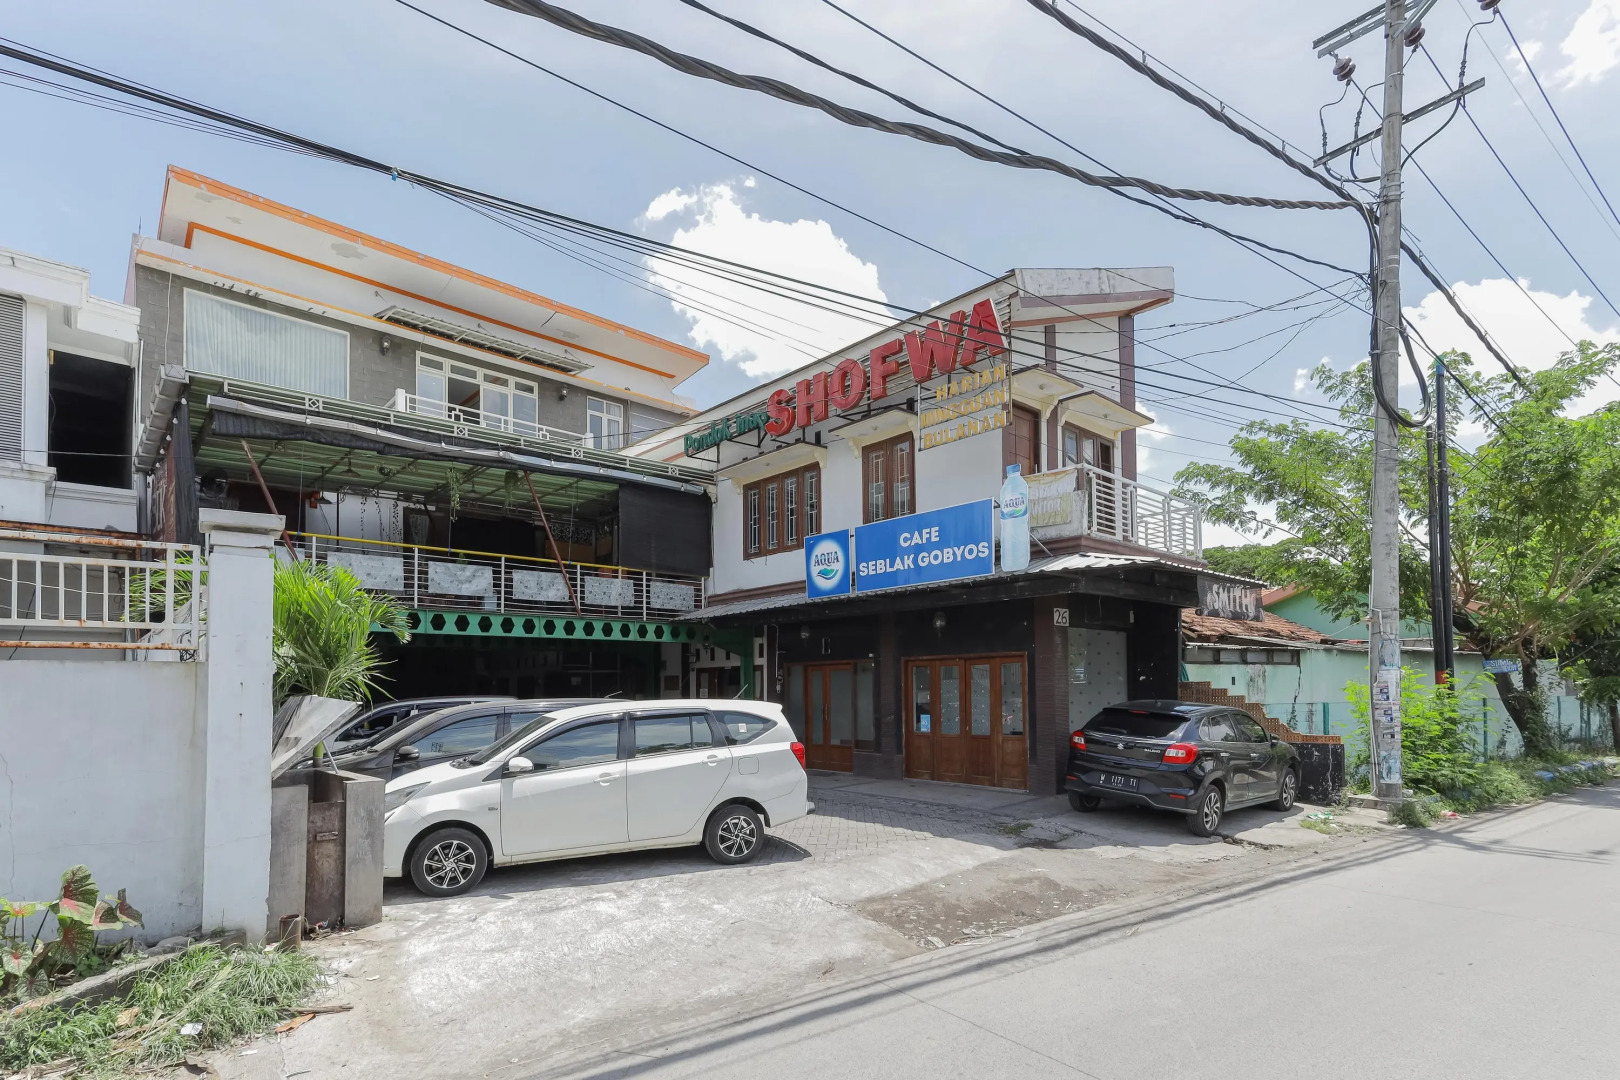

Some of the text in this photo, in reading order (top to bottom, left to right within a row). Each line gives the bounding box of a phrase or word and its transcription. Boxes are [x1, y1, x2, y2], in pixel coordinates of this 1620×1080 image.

[684, 417, 733, 456] Pondok
[765, 298, 1008, 438] SHOFWA
[936, 363, 1006, 402] HARIAN
[920, 387, 1006, 428] MINGGUAN
[922, 411, 1006, 449] BULANAN
[1003, 496, 1025, 508] AQUA
[900, 527, 940, 547] CAFE
[814, 551, 840, 567] AQUA
[859, 542, 989, 577] SEBLAK GOBYOS
[1055, 609, 1067, 625] 26
